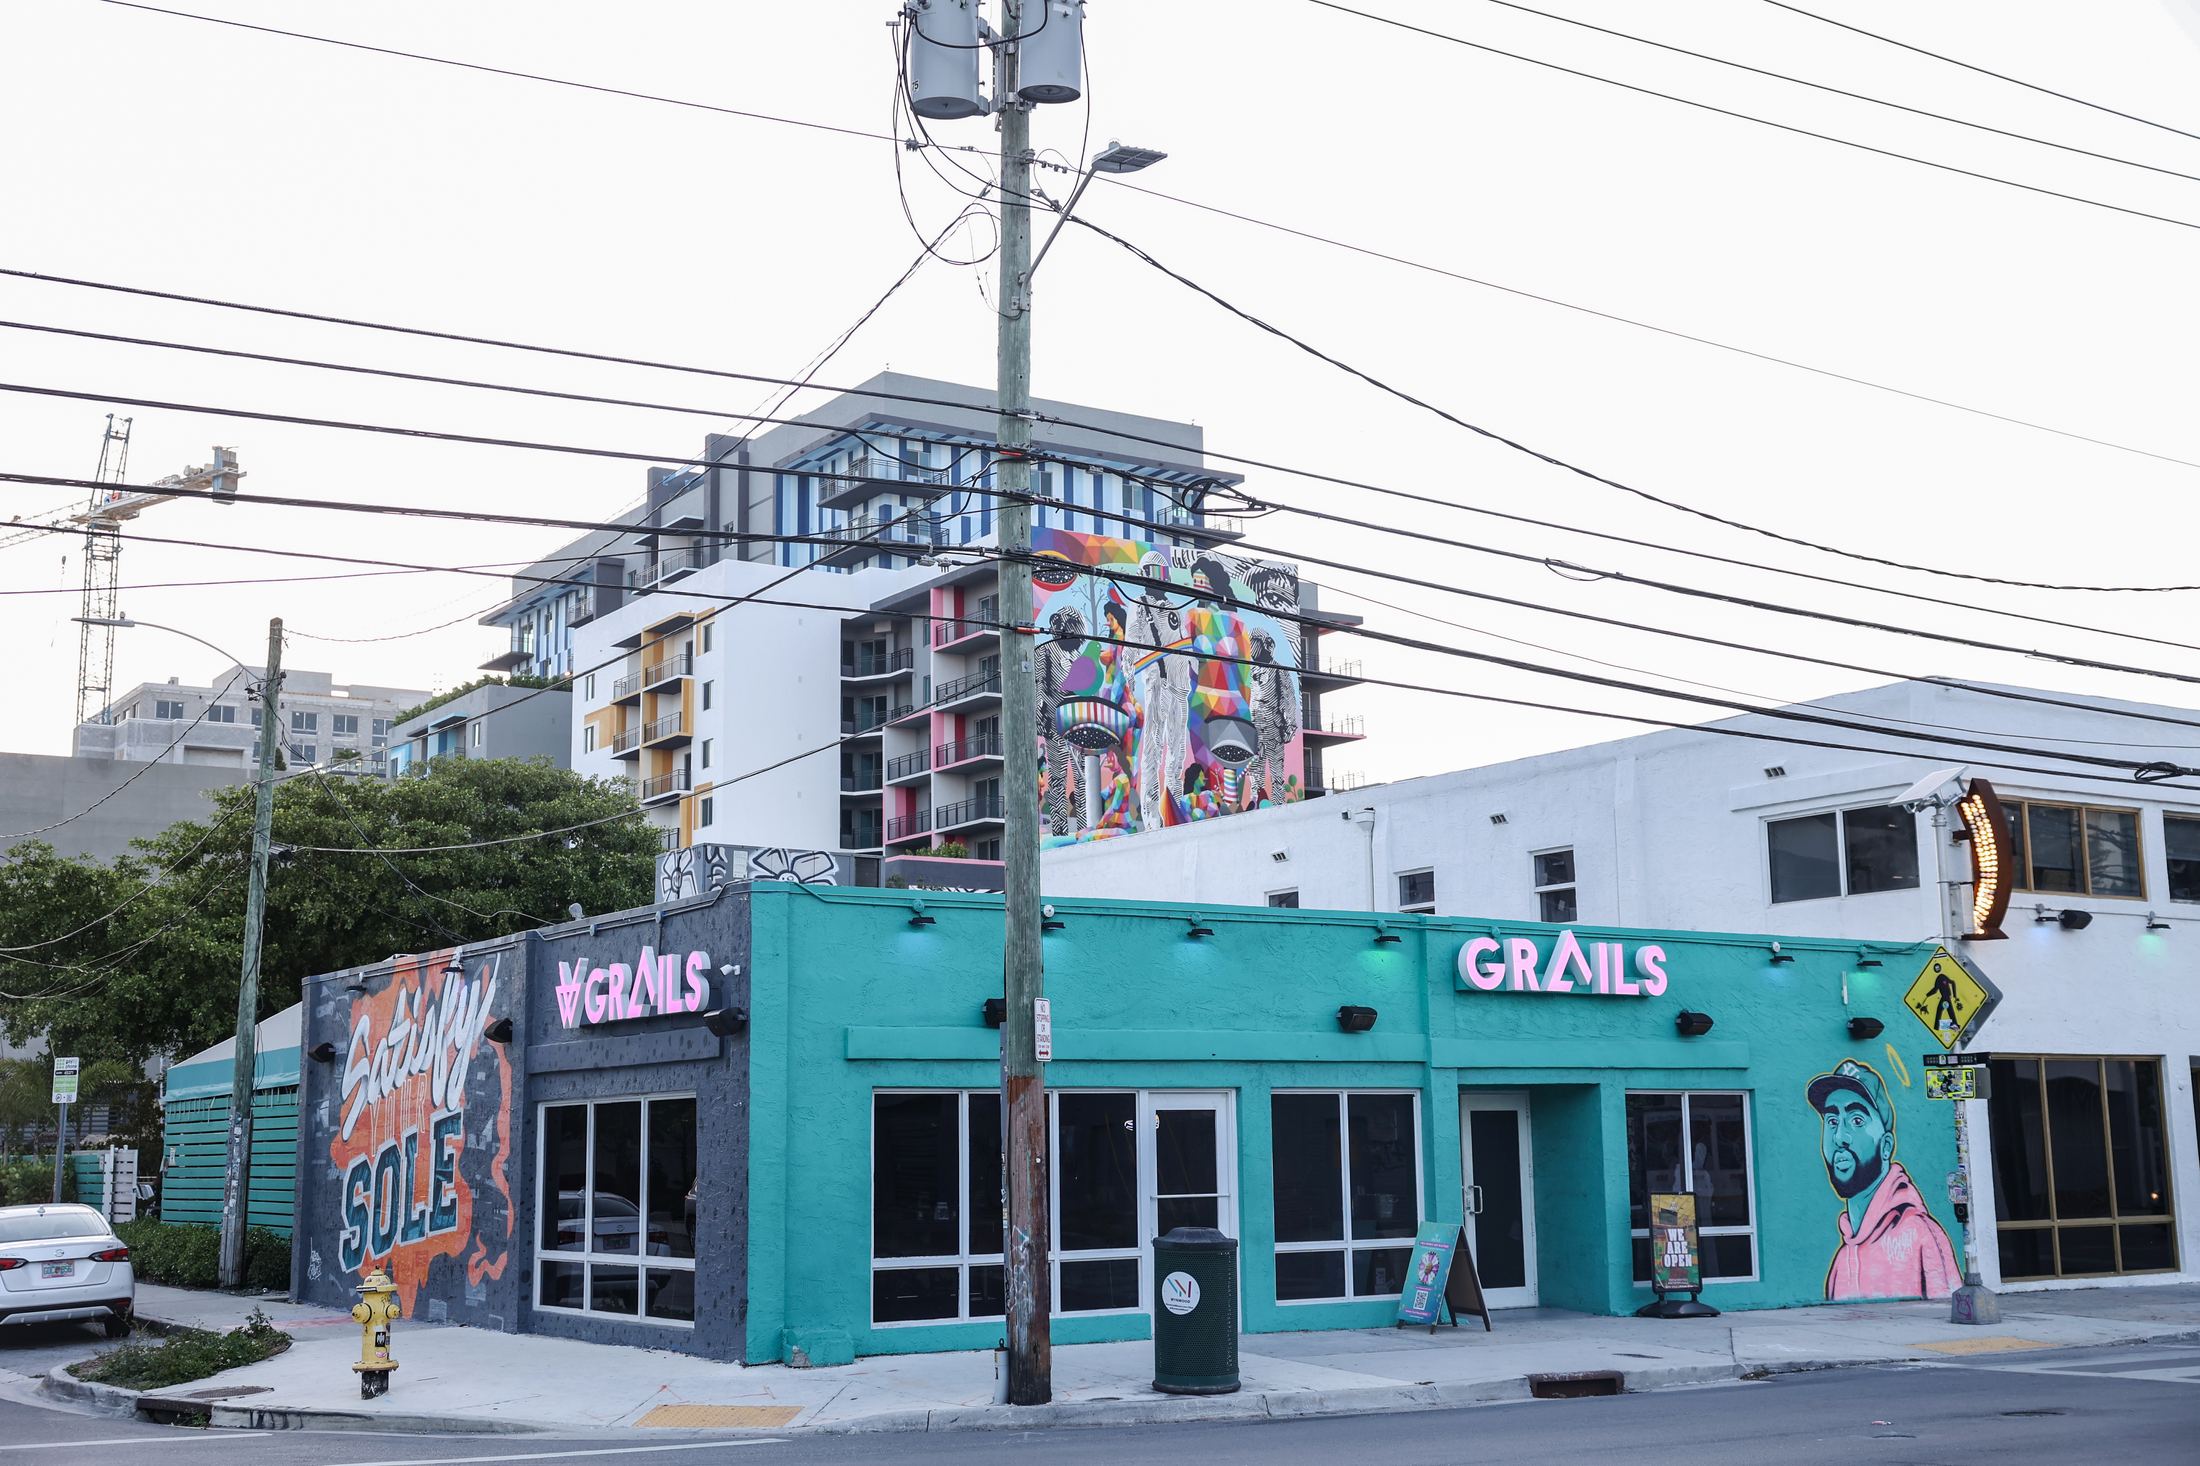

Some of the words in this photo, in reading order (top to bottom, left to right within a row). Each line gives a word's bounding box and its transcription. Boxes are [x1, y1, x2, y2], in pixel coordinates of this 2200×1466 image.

[584, 945, 712, 1024] GRAILS
[1457, 929, 1668, 996] GRAILS
[341, 952, 501, 1142] Satisfy
[369, 1072, 429, 1158] YOUR
[338, 1107, 464, 1274] SOLE
[1663, 1254, 1693, 1268] OPEN
[1666, 1228, 1685, 1242] WE
[1666, 1241, 1688, 1255] ARE
